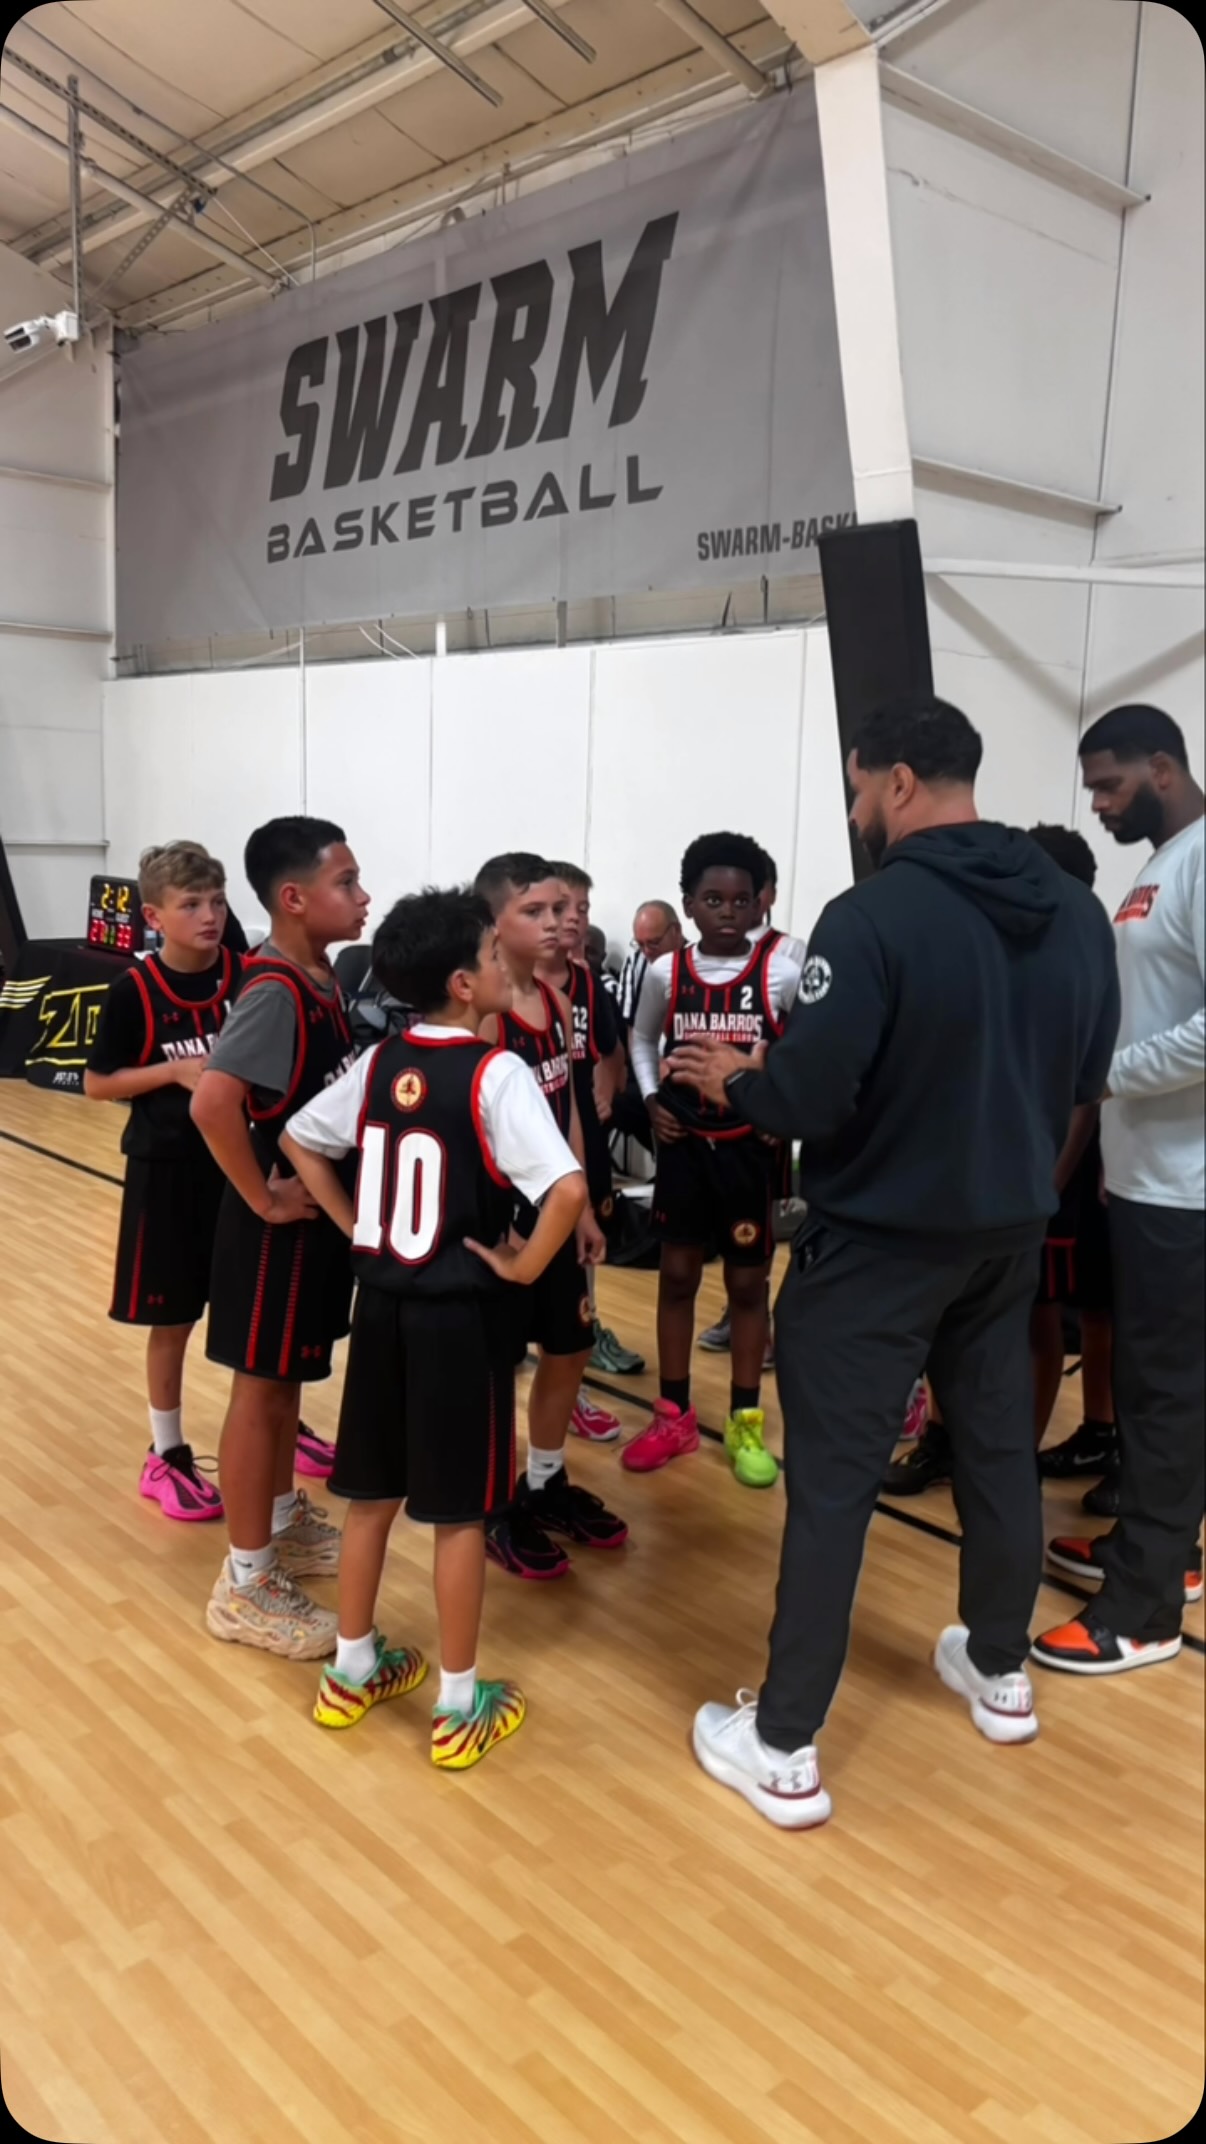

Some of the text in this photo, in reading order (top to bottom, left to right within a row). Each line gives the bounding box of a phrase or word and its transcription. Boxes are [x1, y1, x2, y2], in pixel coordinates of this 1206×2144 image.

[269, 210, 679, 501] SWARM
[267, 454, 664, 563] BASKETBALL
[697, 511, 858, 561] SWARM-BASK
[673, 1012, 764, 1042] DANA BARROS
[741, 985, 753, 1010] 2
[353, 1123, 444, 1263] 10
